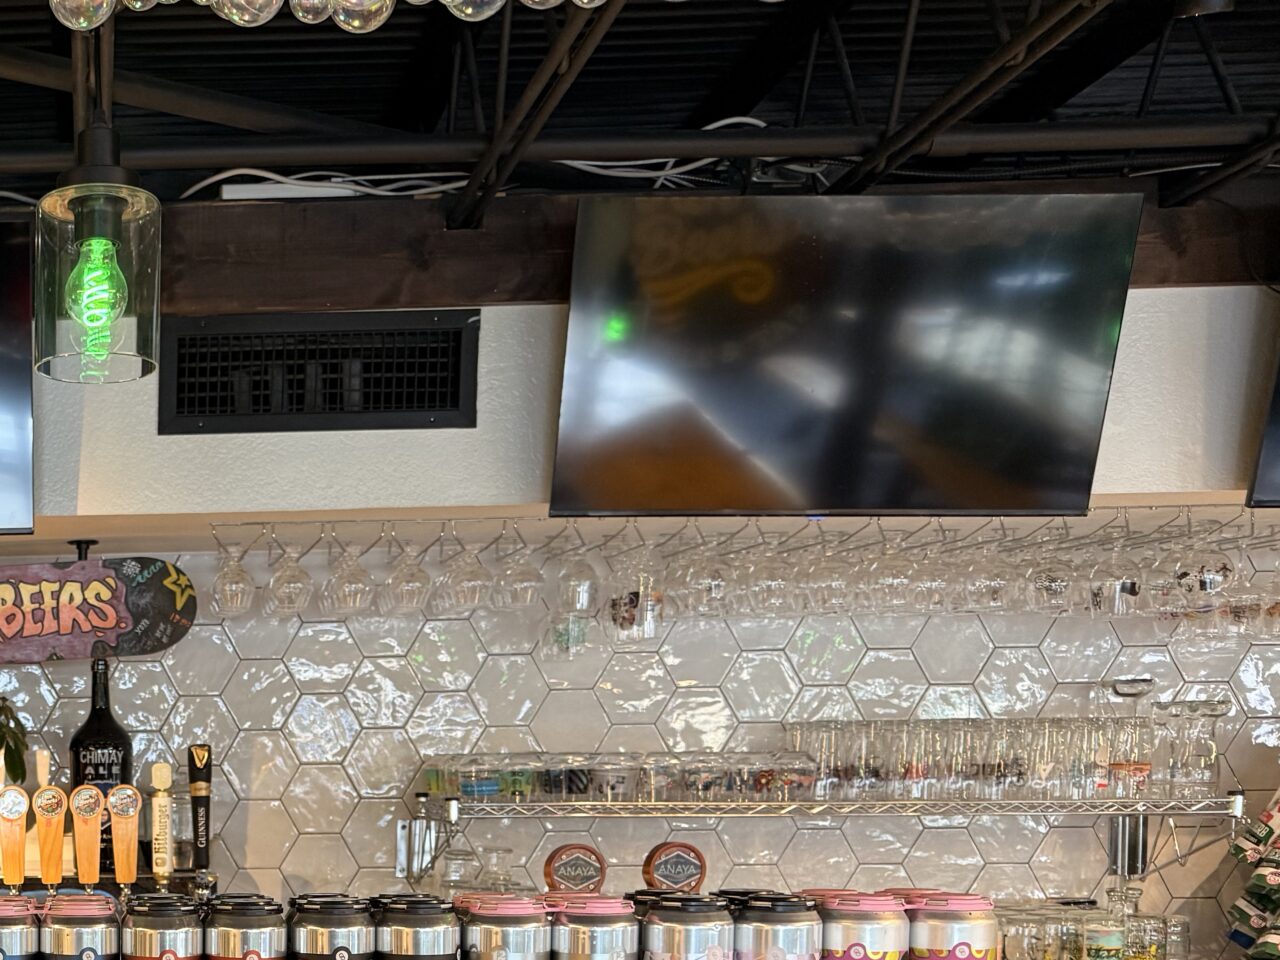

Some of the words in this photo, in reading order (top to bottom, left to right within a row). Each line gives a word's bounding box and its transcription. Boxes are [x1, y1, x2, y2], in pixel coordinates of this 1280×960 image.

[80, 751, 124, 764] CHIMAY
[84, 766, 120, 774] ALE
[197, 807, 206, 848] GUINNESS
[558, 866, 596, 876] ANAYA
[658, 864, 696, 874] ANAYA
[492, 950, 506, 960] 12
